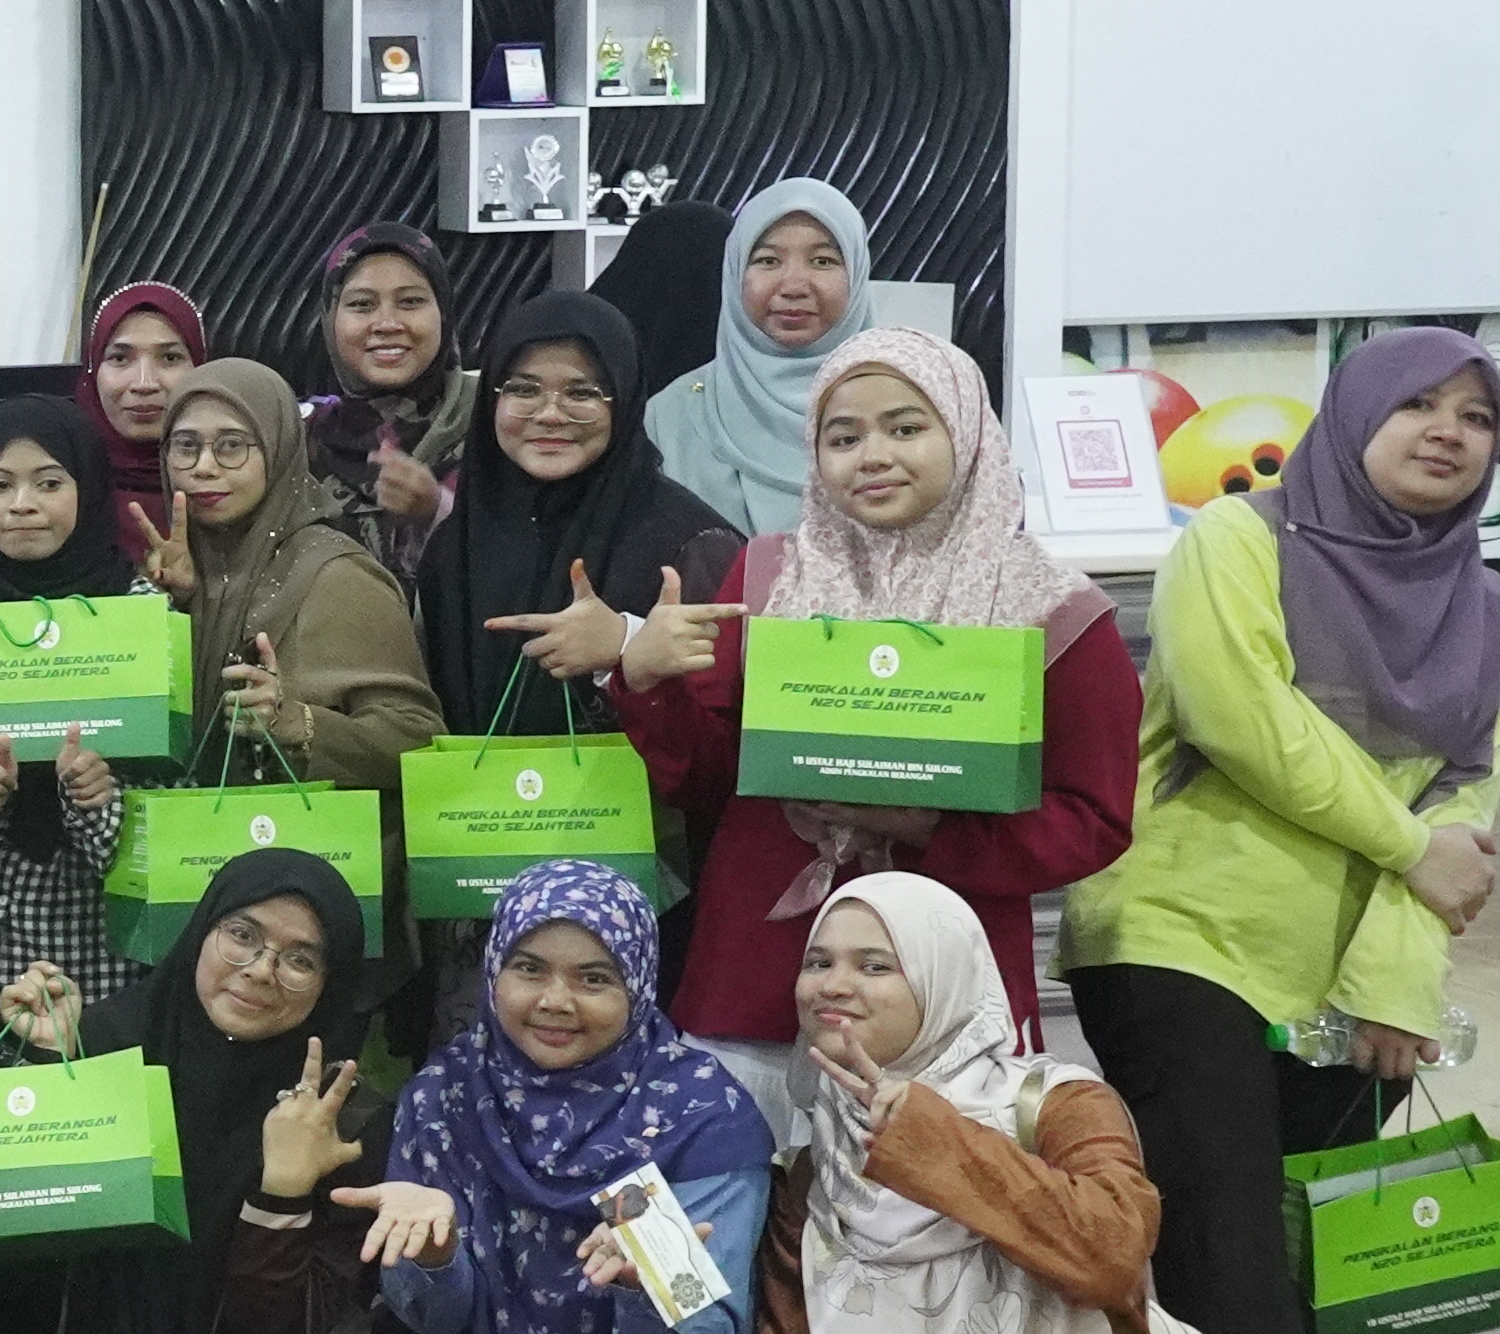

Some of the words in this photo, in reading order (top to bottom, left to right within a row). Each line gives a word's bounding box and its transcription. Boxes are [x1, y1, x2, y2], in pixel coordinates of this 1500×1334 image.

[779, 682, 885, 697] PENGKALAN
[887, 688, 986, 702] BERANGAN
[850, 699, 952, 714] SEJAHTERA
